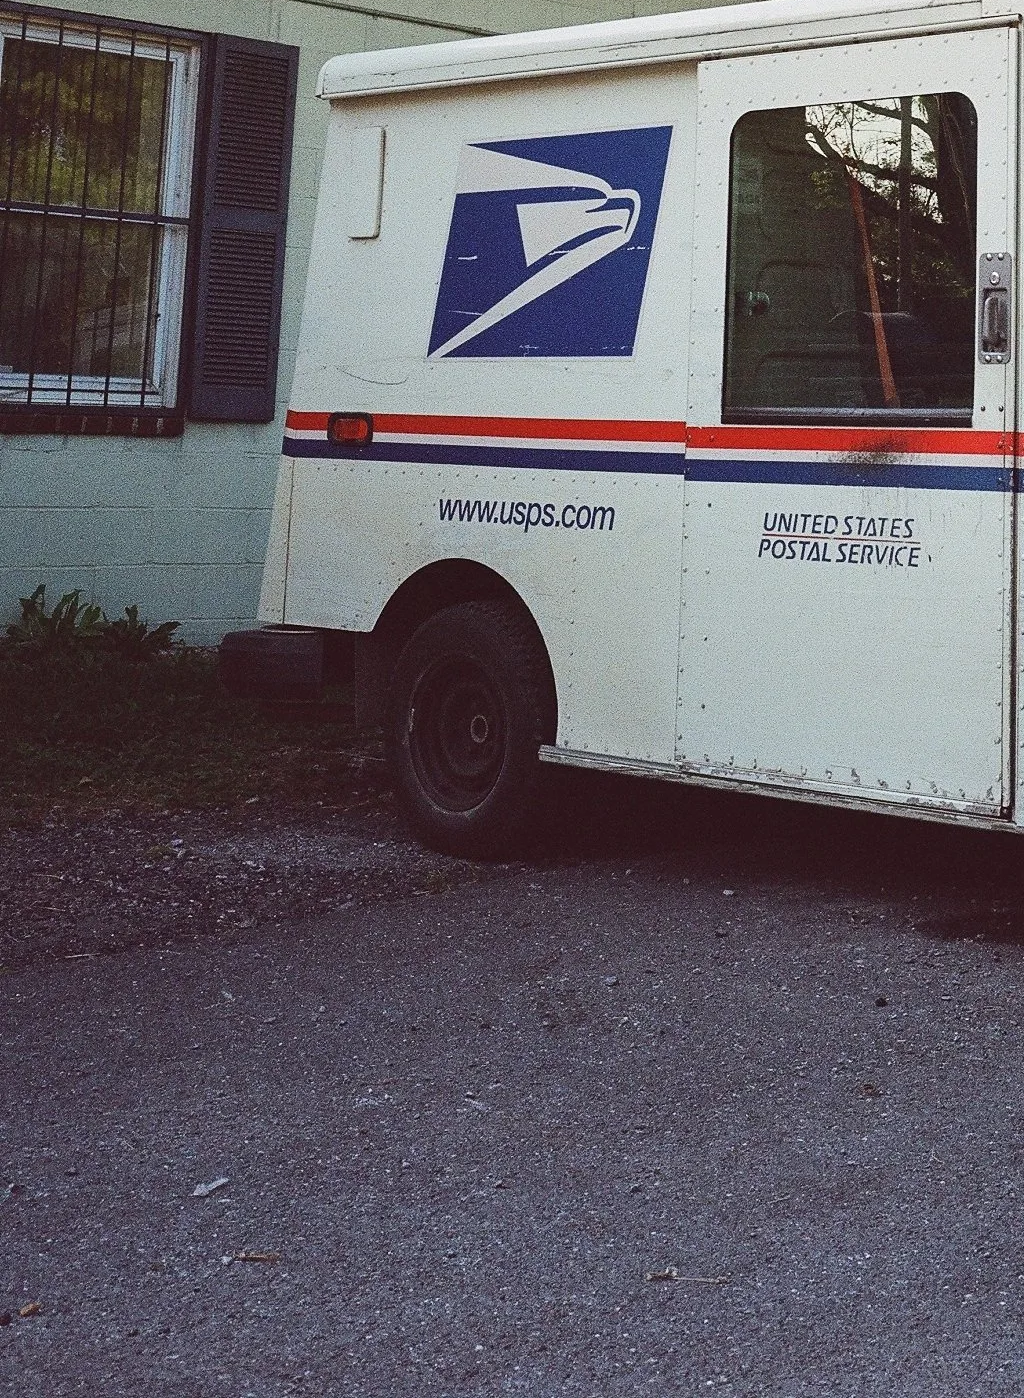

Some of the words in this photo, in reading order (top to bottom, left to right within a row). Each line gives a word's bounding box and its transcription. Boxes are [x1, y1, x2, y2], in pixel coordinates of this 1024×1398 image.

[439, 498, 615, 533] www.usps.com
[763, 512, 838, 534] UNITED
[841, 516, 915, 539] STATES
[758, 539, 831, 563] POSTAL
[835, 543, 922, 568] SERVICE
